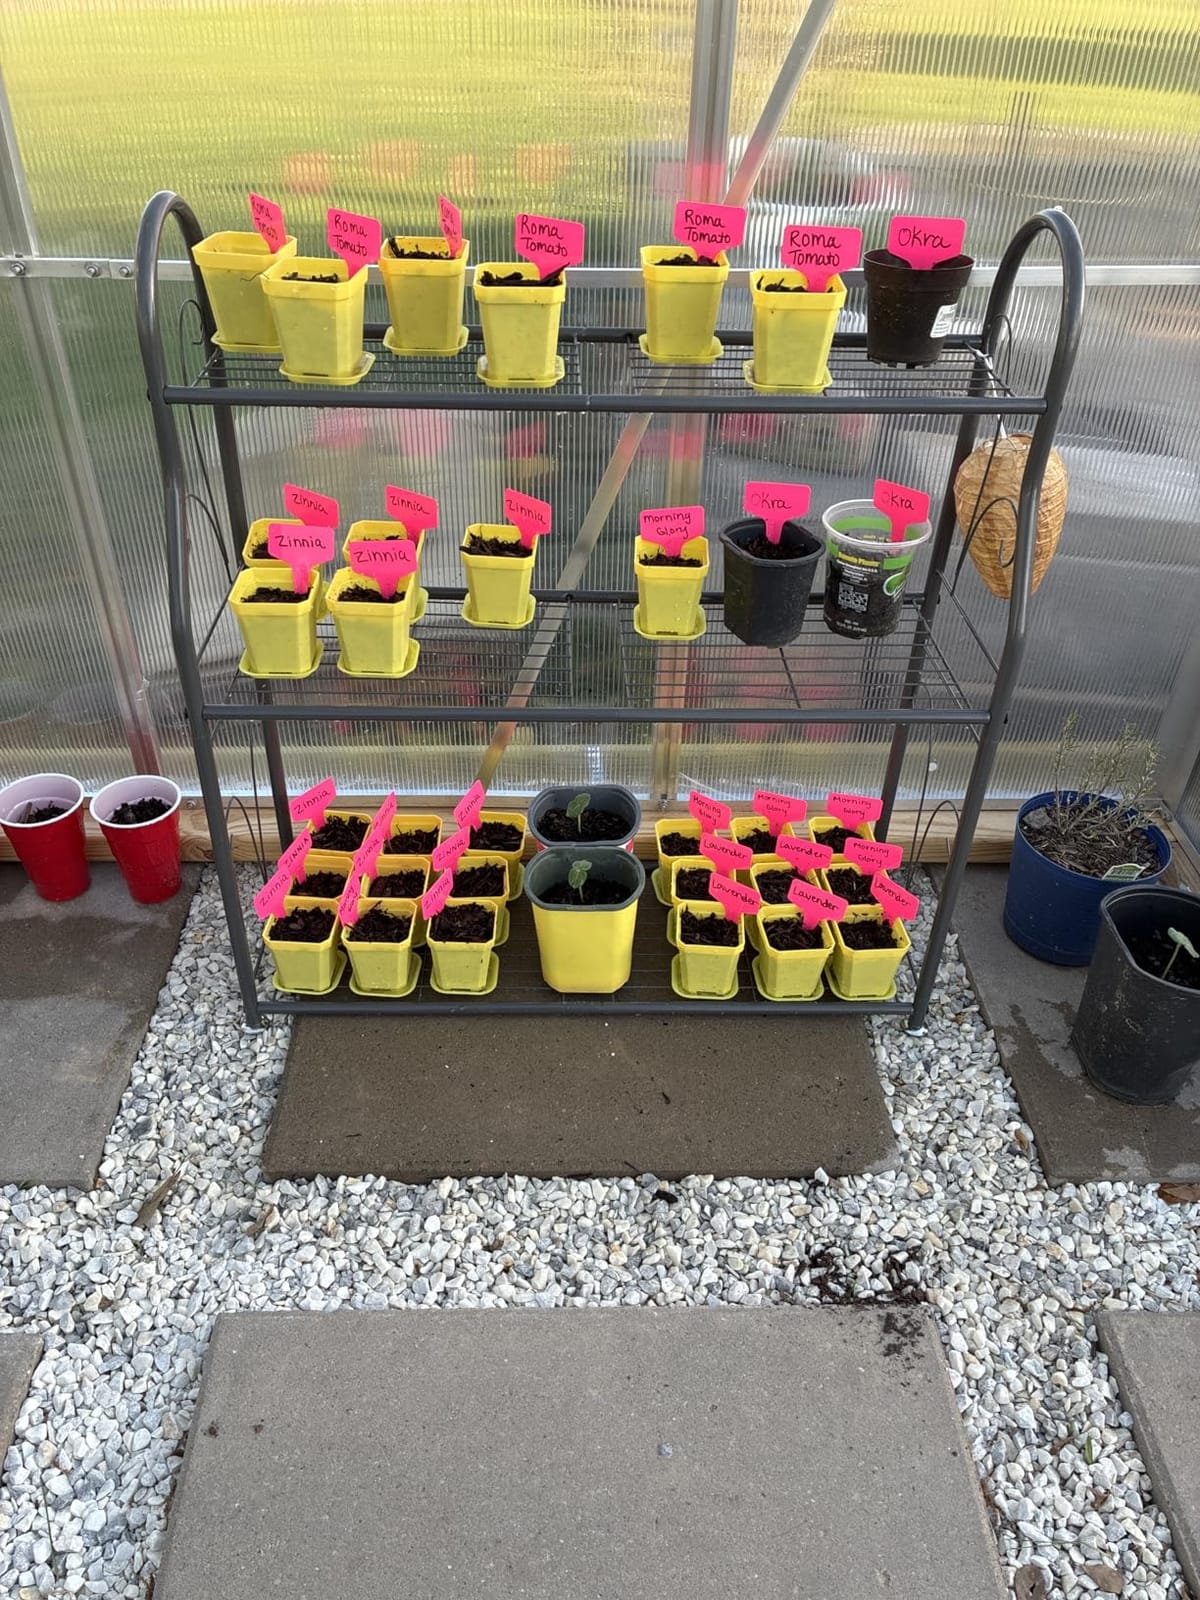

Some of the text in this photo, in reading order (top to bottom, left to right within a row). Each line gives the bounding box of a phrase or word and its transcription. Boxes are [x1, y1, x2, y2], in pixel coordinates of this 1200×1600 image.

[334, 214, 368, 238] Roma
[520, 214, 564, 240] Roma
[685, 209, 726, 228] Roma
[684, 226, 731, 244] Tomato
[790, 230, 841, 249] Roma
[332, 234, 368, 257] Tomato
[520, 237, 568, 257] Tomato
[789, 249, 840, 267] Tomato
[292, 493, 329, 516] Zinnia
[390, 495, 430, 515] Zinnia
[505, 499, 547, 526] Zinnia
[275, 535, 327, 550] Zinnia
[656, 525, 689, 540] Glory
[354, 547, 411, 564] Zinnia
[294, 789, 331, 815] Zinnia
[780, 842, 828, 859] Lavender
[853, 842, 890, 858] Morning
[260, 873, 290, 907] Zinnia
[793, 887, 839, 911] Lavender
